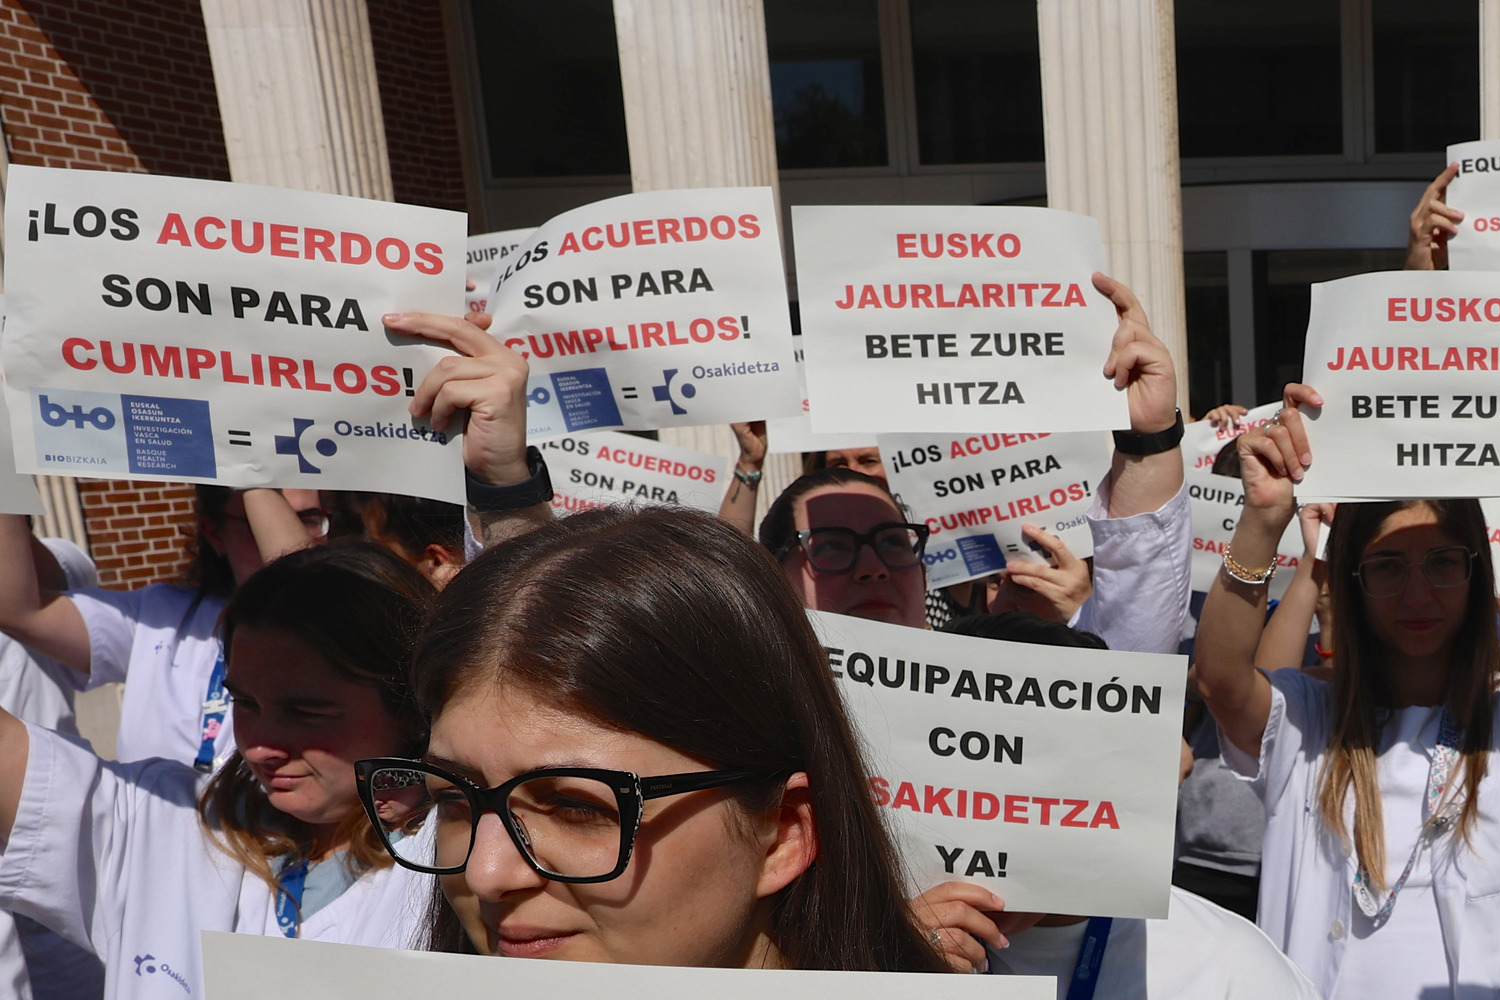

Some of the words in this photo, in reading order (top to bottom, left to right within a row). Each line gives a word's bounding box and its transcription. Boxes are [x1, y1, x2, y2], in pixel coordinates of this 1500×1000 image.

[28, 202, 140, 242] ¡LOS
[158, 212, 444, 274] ACUERDOS
[496, 241, 548, 293] ¡LOS
[558, 214, 760, 256] ACUERDOS
[896, 234, 1020, 258] EUSKO
[102, 274, 212, 316] SON
[230, 286, 368, 332] PARA
[524, 278, 598, 308] SON
[612, 268, 714, 298] PARA
[836, 284, 1086, 310] JAURLARITZA
[504, 316, 750, 361] CUMPLIRLOS!
[866, 334, 958, 358] BETE
[970, 332, 1064, 356] ZURE
[61, 338, 415, 397] CUMPLIRLOS!
[692, 361, 779, 379] Osakidetza
[916, 382, 1024, 404] HITZA
[1352, 396, 1440, 418] BETE
[133, 426, 192, 435] INVESTIGACIÓN
[333, 420, 448, 444] Osakidetza
[45, 454, 107, 464] BIOBIZKAIA
[596, 446, 716, 484] ACUERDOS
[892, 445, 942, 473] ¡LOS
[1398, 444, 1500, 466] HITZA
[570, 469, 614, 490] SON
[622, 481, 680, 503] PARA
[934, 473, 985, 498] SON
[991, 455, 1062, 486] PARA
[924, 480, 1092, 535] CUMPLIRLOS!
[826, 647, 1161, 714] EQUIPARACIÓN
[928, 726, 1024, 764] CON
[869, 776, 1120, 830] SAKIDETZA
[934, 844, 1008, 878] YA!
